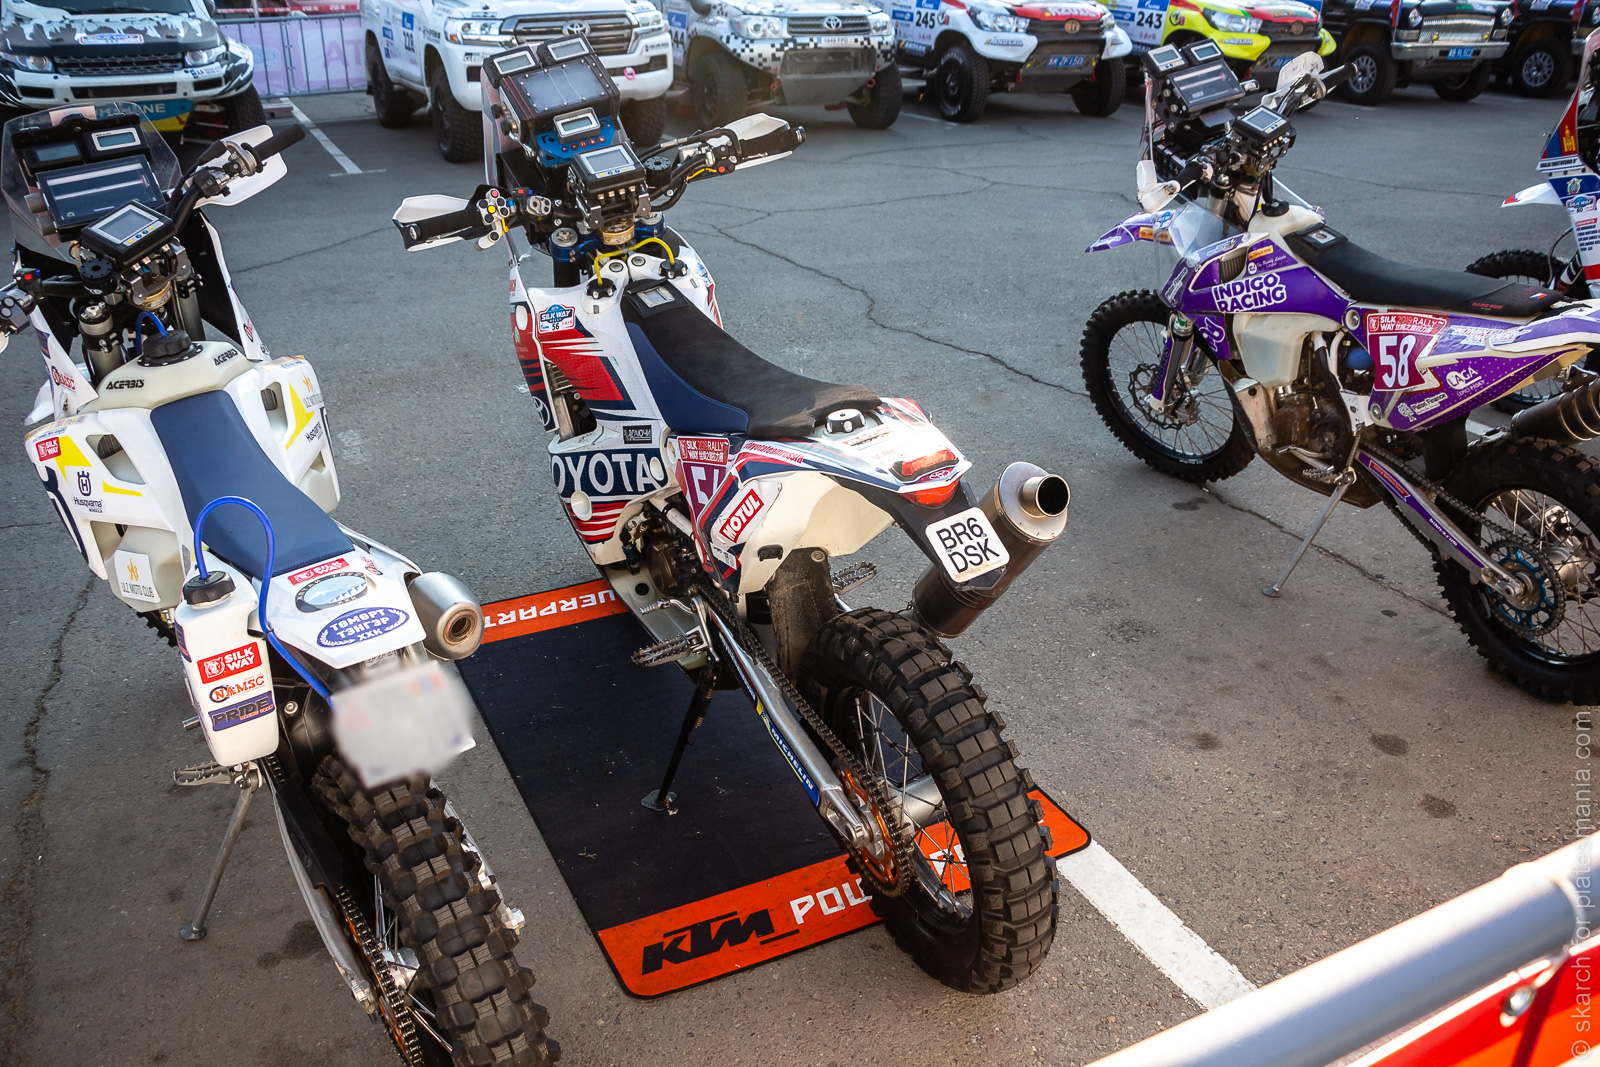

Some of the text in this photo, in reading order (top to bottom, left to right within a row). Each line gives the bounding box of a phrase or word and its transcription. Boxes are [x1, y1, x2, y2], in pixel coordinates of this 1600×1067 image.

[915, 10, 936, 29] 245
[1136, 11, 1163, 29] 243
[1213, 273, 1279, 301] INDIGO
[1217, 286, 1285, 312] RACING
[541, 309, 571, 321] SILK WAY
[1380, 315, 1437, 327] SILK 2019 RALLY
[551, 323, 560, 331] 56
[1381, 323, 1395, 331] WAY
[213, 348, 239, 367] ACERBIS
[1379, 335, 1416, 388] 58
[106, 379, 145, 390] ACERBIS
[1447, 366, 1479, 388] LAGA
[45, 439, 59, 448] SILK
[46, 446, 59, 455] WAY
[686, 440, 697, 450] SILK
[707, 441, 725, 452] RALLY
[73, 497, 103, 508] Husqvarna
[722, 494, 761, 541] MOTUL
[936, 517, 984, 550] BR6
[948, 538, 1000, 574] DSK
[121, 582, 155, 598] ULZ MOTO CLUB
[336, 616, 390, 639] ТЭНГЭР
[356, 628, 383, 641] ХХК
[224, 646, 254, 664] SILK
[226, 655, 255, 672] WAY
[214, 675, 265, 701] NAMSC
[212, 695, 269, 726] PRIDE
[240, 704, 274, 721] RACING TEAM
[771, 728, 814, 790] MICHELIN
[642, 909, 775, 976] KTM
